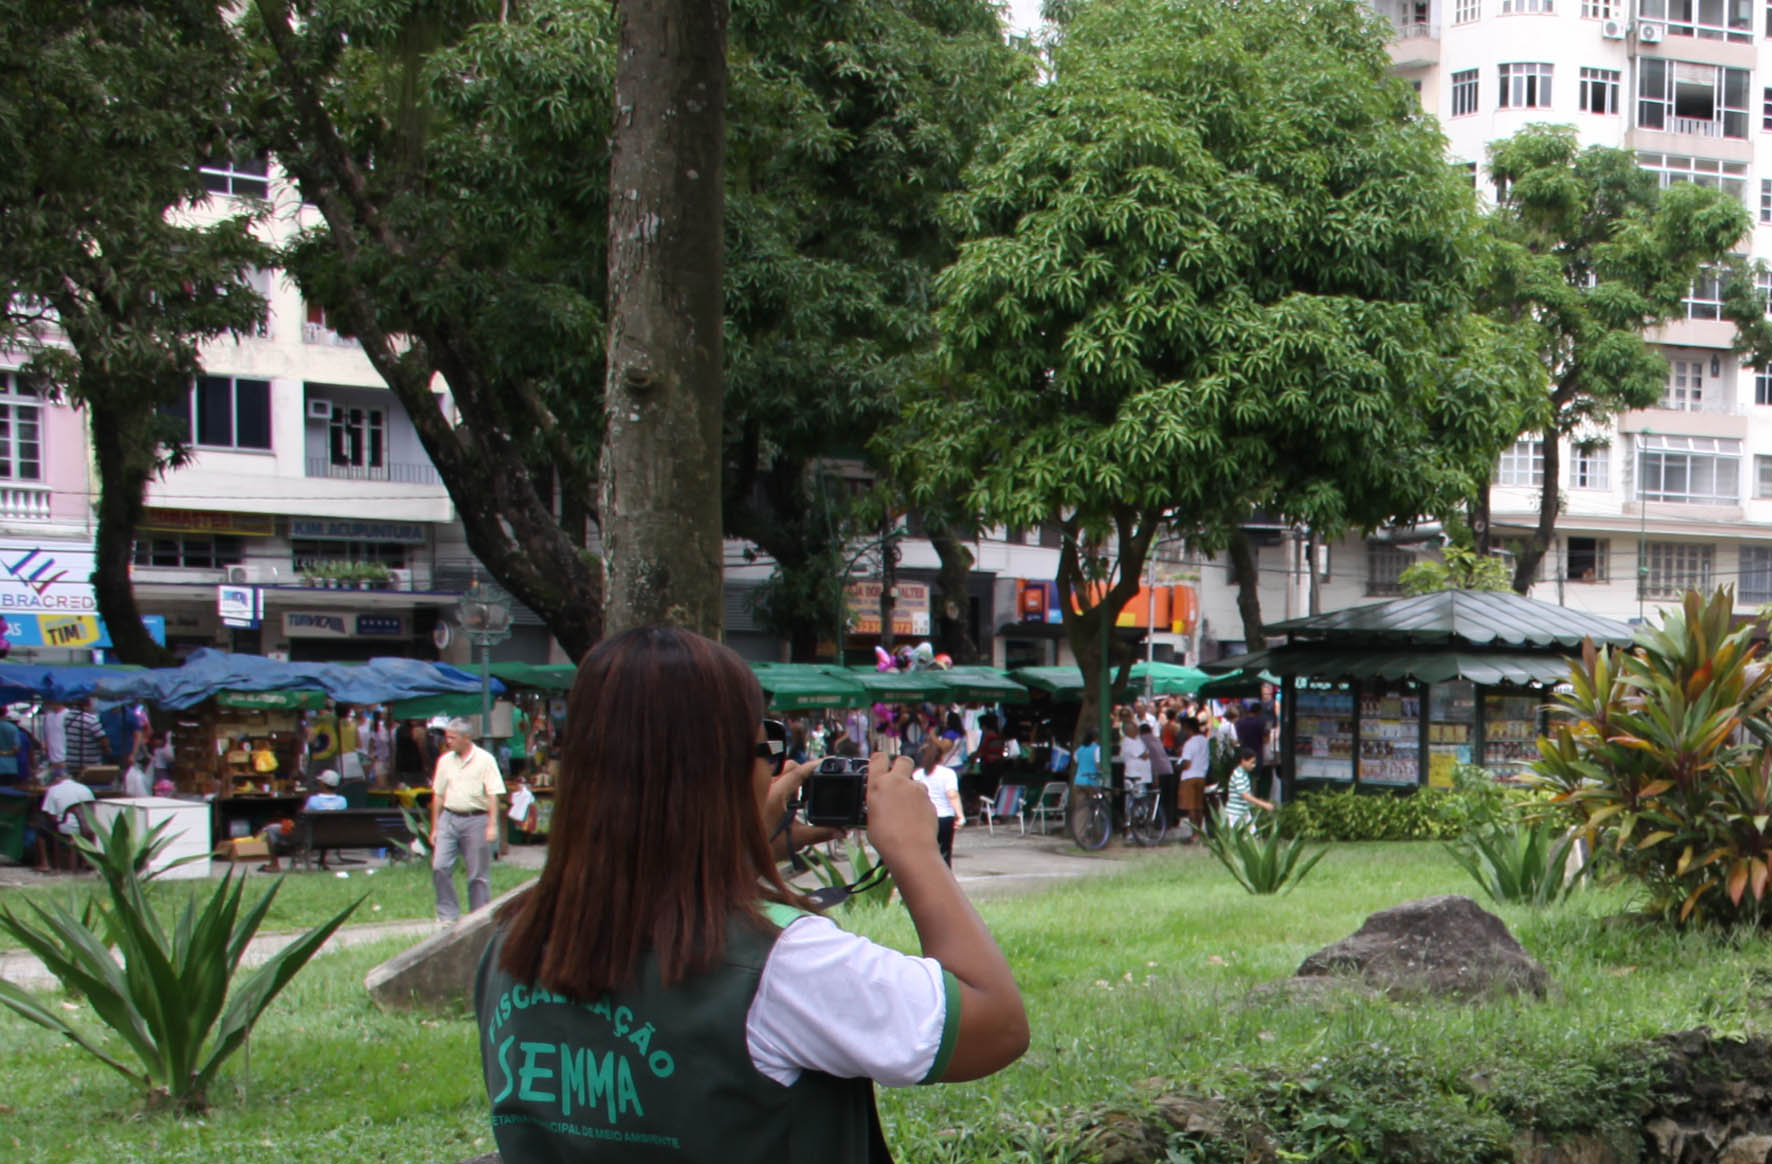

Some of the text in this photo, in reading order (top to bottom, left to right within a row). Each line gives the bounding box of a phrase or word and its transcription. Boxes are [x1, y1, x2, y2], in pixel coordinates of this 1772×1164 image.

[47, 624, 81, 646] TIM
[488, 983, 676, 1078] FISCAAÇÃO
[493, 1034, 645, 1125] SEMMA
